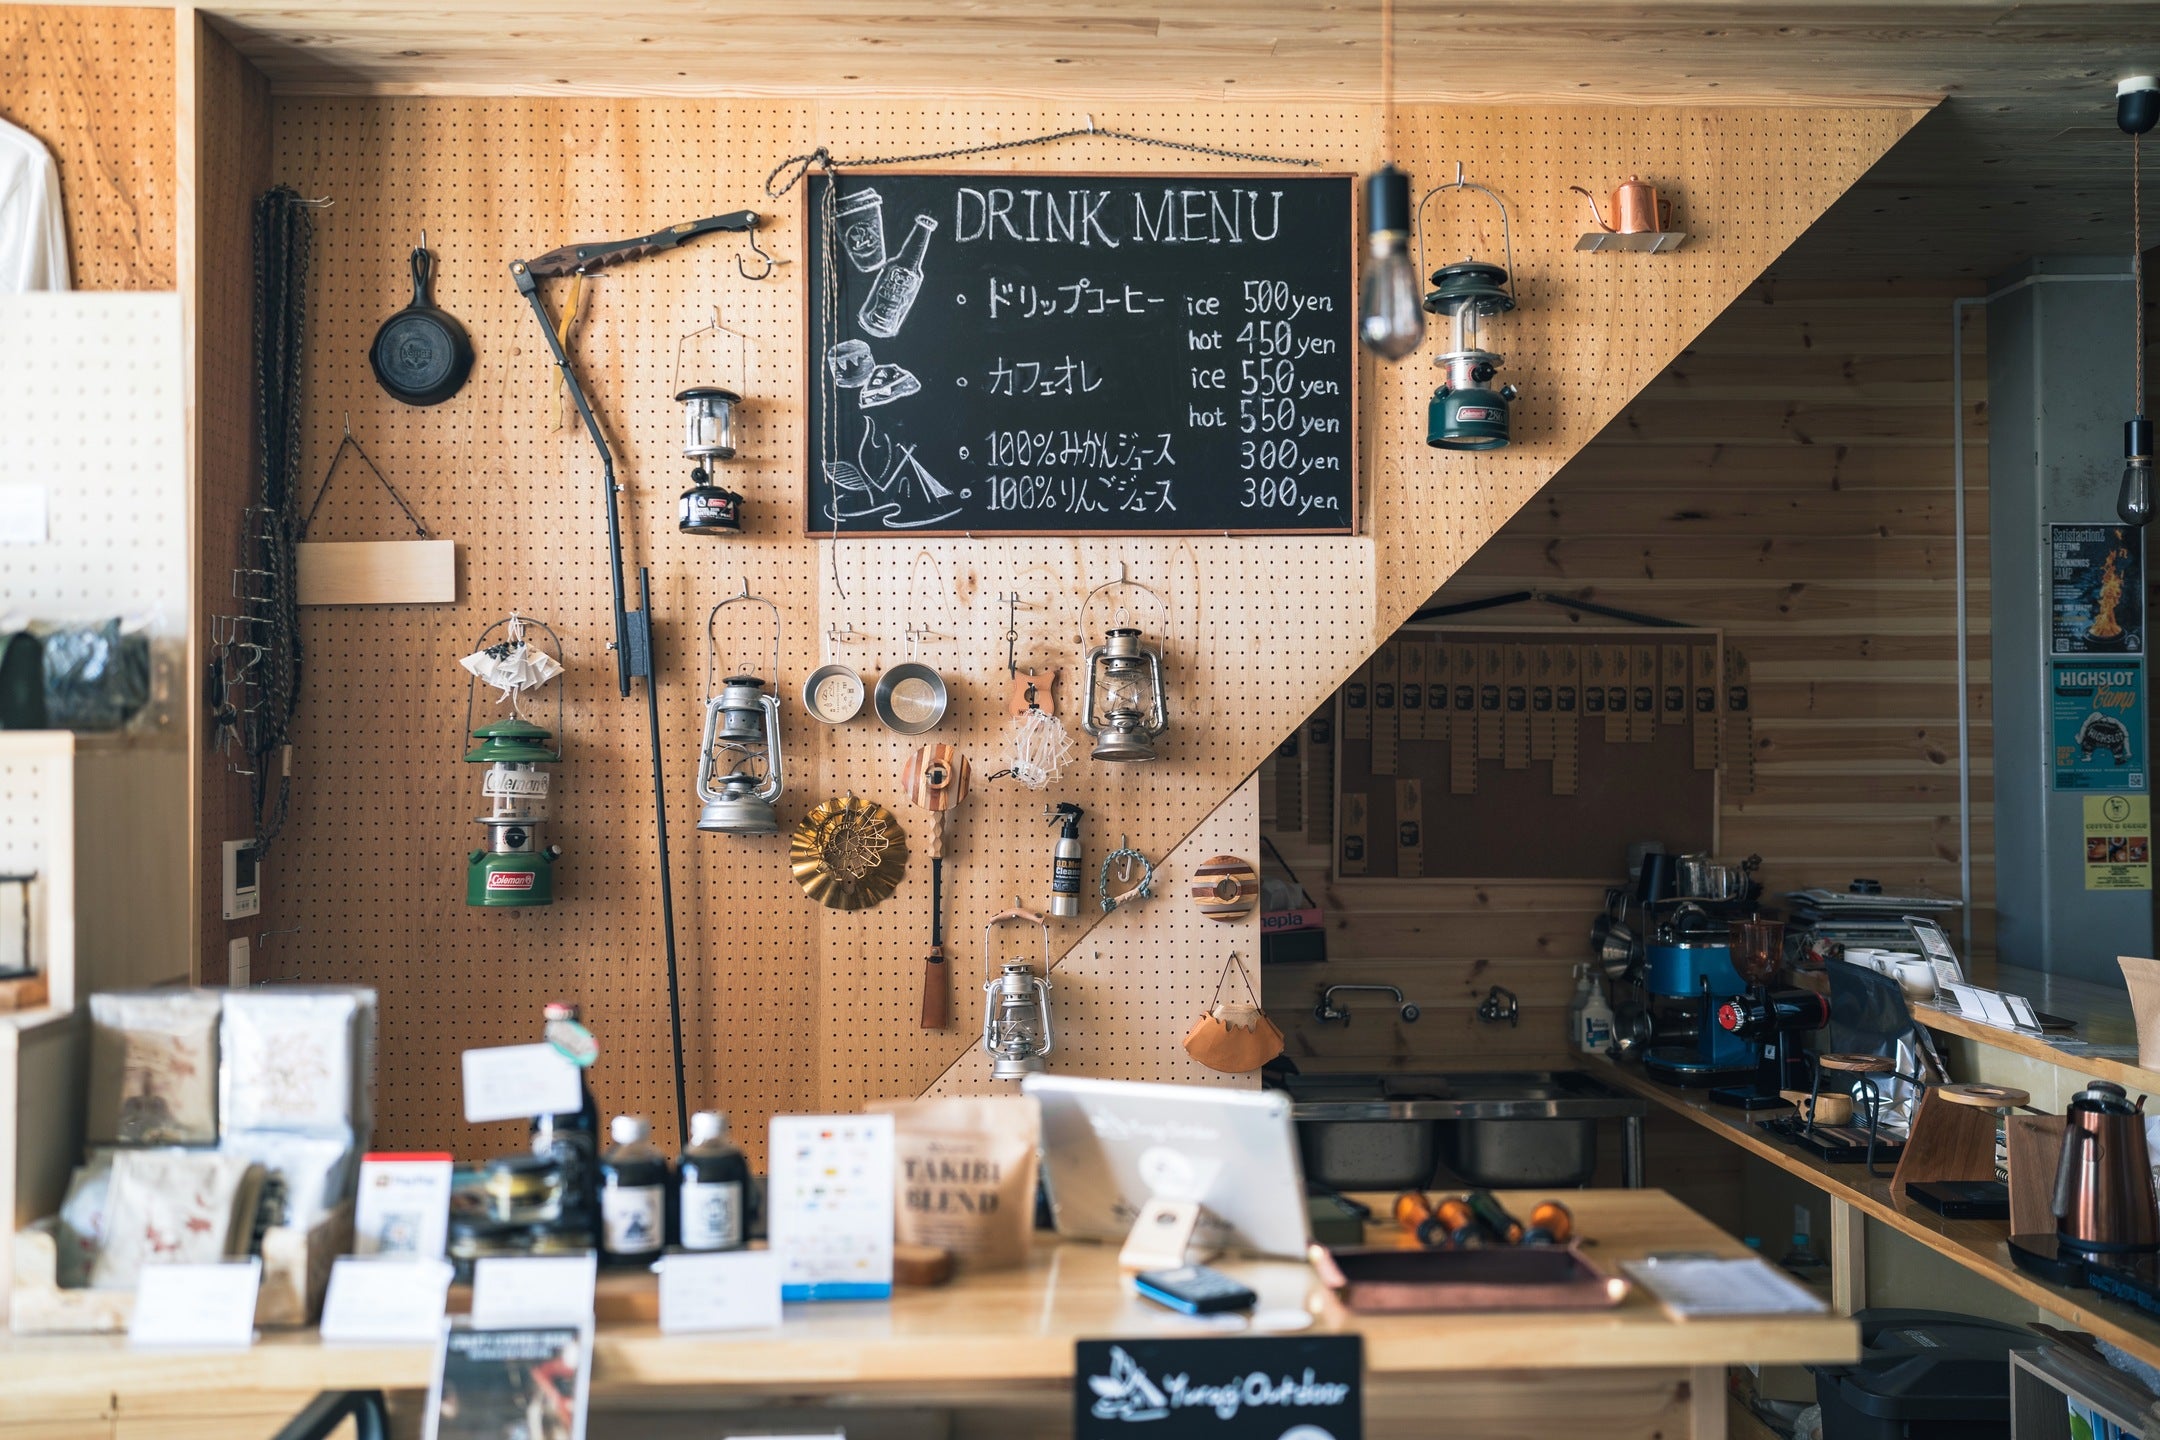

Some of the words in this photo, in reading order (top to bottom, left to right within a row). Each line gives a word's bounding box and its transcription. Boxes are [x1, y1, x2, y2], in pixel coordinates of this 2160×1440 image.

[955, 187, 1121, 248] DRINK
[1132, 189, 1284, 244] MENU
[988, 277, 1166, 319] ドリップコーヒー
[1186, 296, 1221, 316] ice
[1187, 329, 1223, 351] hot
[988, 355, 1103, 396] カフェオレ
[1191, 367, 1227, 390] ice
[1188, 405, 1227, 428] hot
[2060, 672, 2134, 686] HIGHSLOT
[487, 773, 540, 791] Cleman
[491, 874, 526, 887] Coleman
[904, 1158, 1001, 1184] TAKIBI
[905, 1189, 1000, 1213] BLEND
